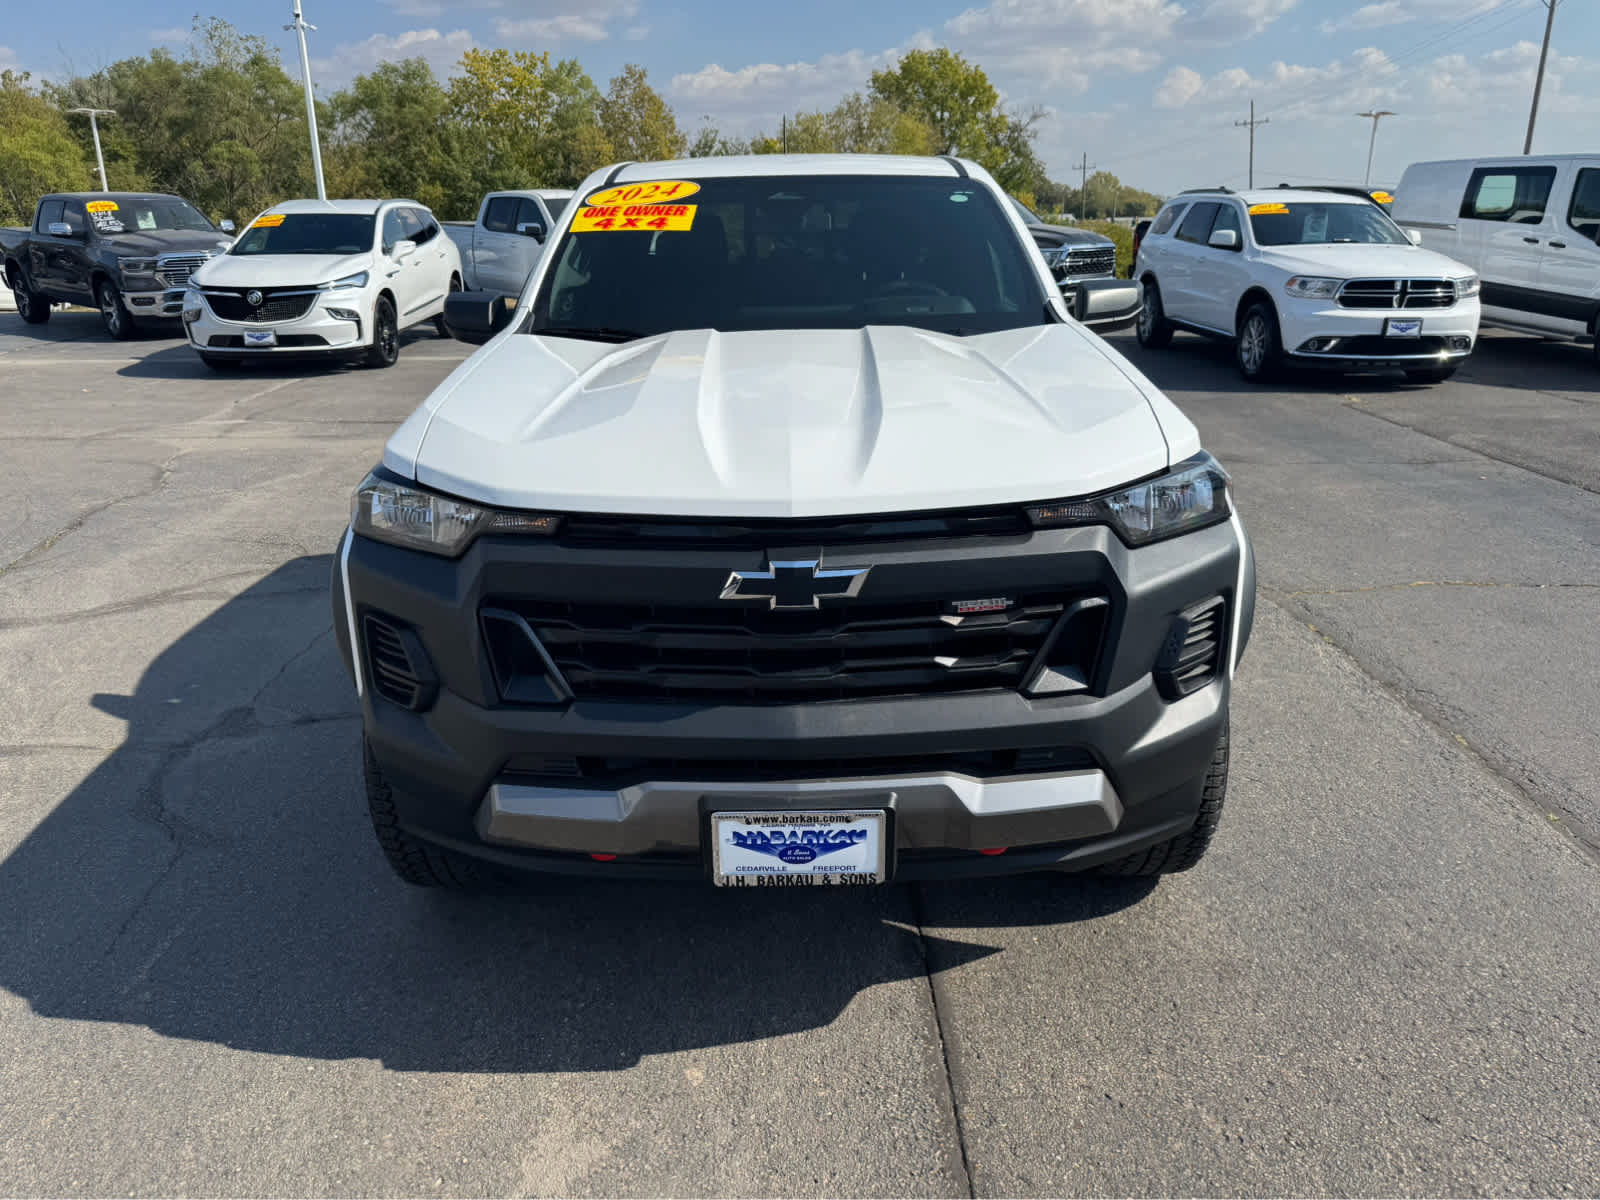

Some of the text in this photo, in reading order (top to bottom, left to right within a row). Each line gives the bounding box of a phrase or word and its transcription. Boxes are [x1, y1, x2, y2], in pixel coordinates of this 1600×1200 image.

[603, 182, 683, 203] 2024
[583, 205, 689, 218] ONE OWNER
[753, 814, 846, 824] www.barkau.com
[722, 873, 877, 888] J.H. BARKAU & SONS
